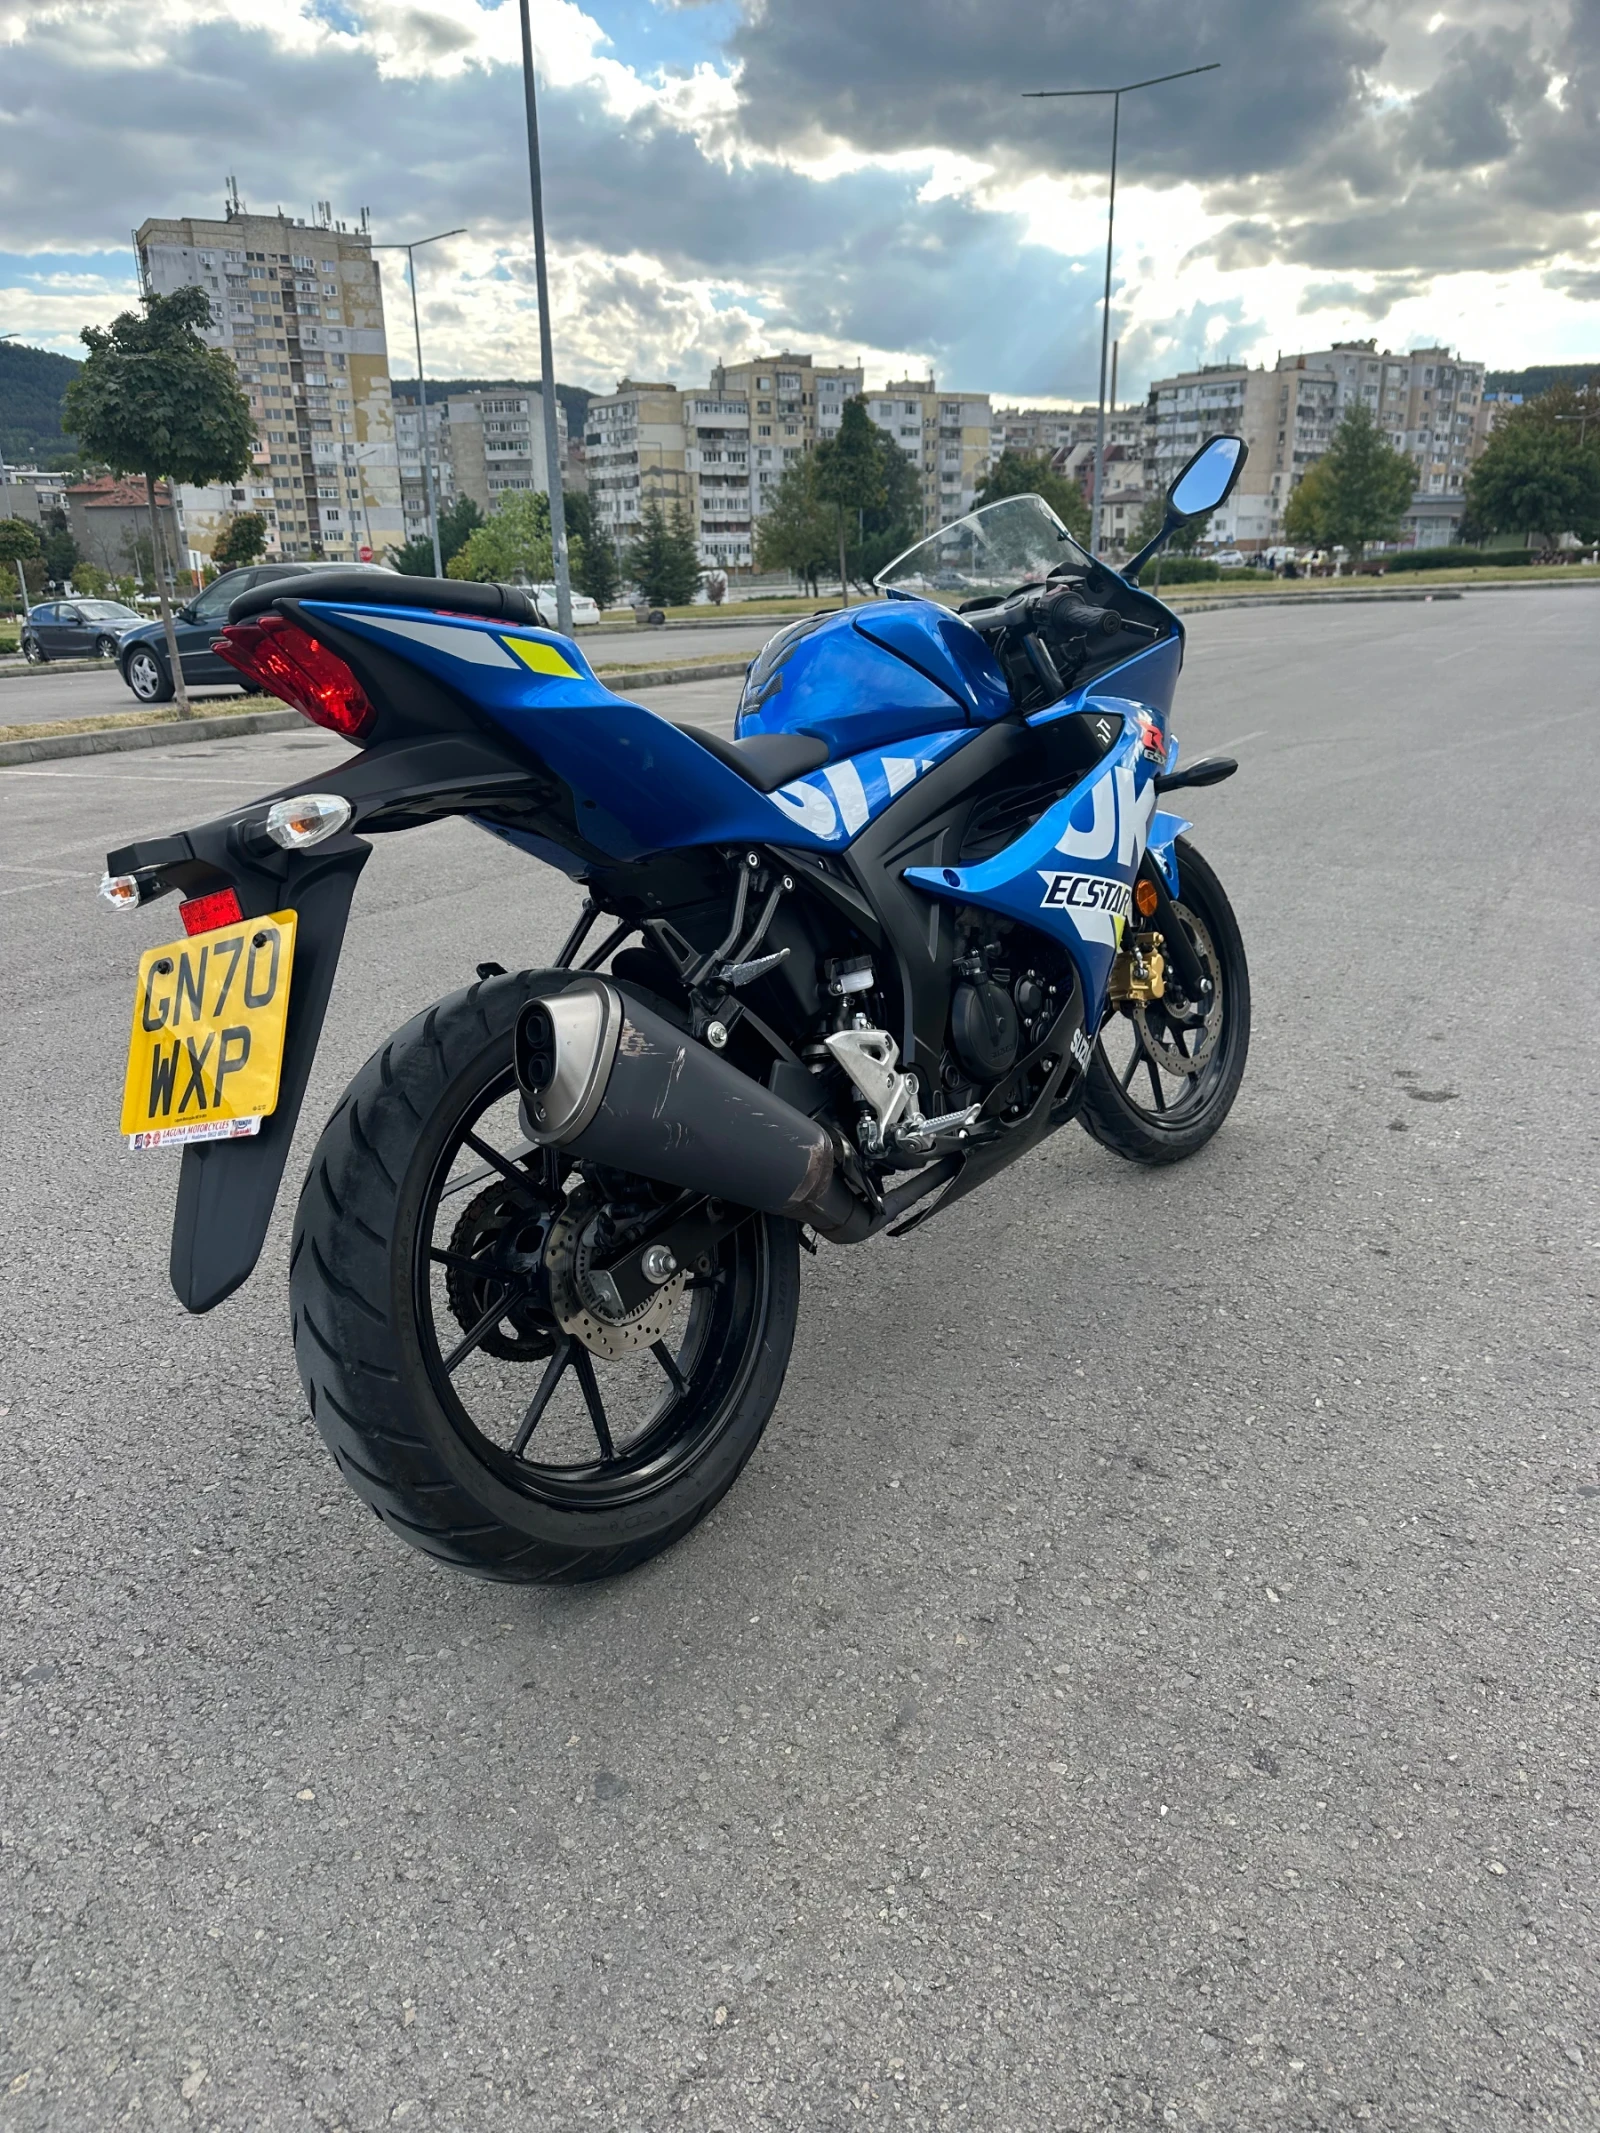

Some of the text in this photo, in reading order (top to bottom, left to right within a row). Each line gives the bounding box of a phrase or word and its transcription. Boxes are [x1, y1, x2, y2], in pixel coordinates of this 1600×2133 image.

[142, 928, 281, 1032] GN70
[148, 1025, 251, 1118] WXP
[162, 1127, 186, 1138] LAGUNA
[187, 1120, 229, 1134] MOTORCYCLES
